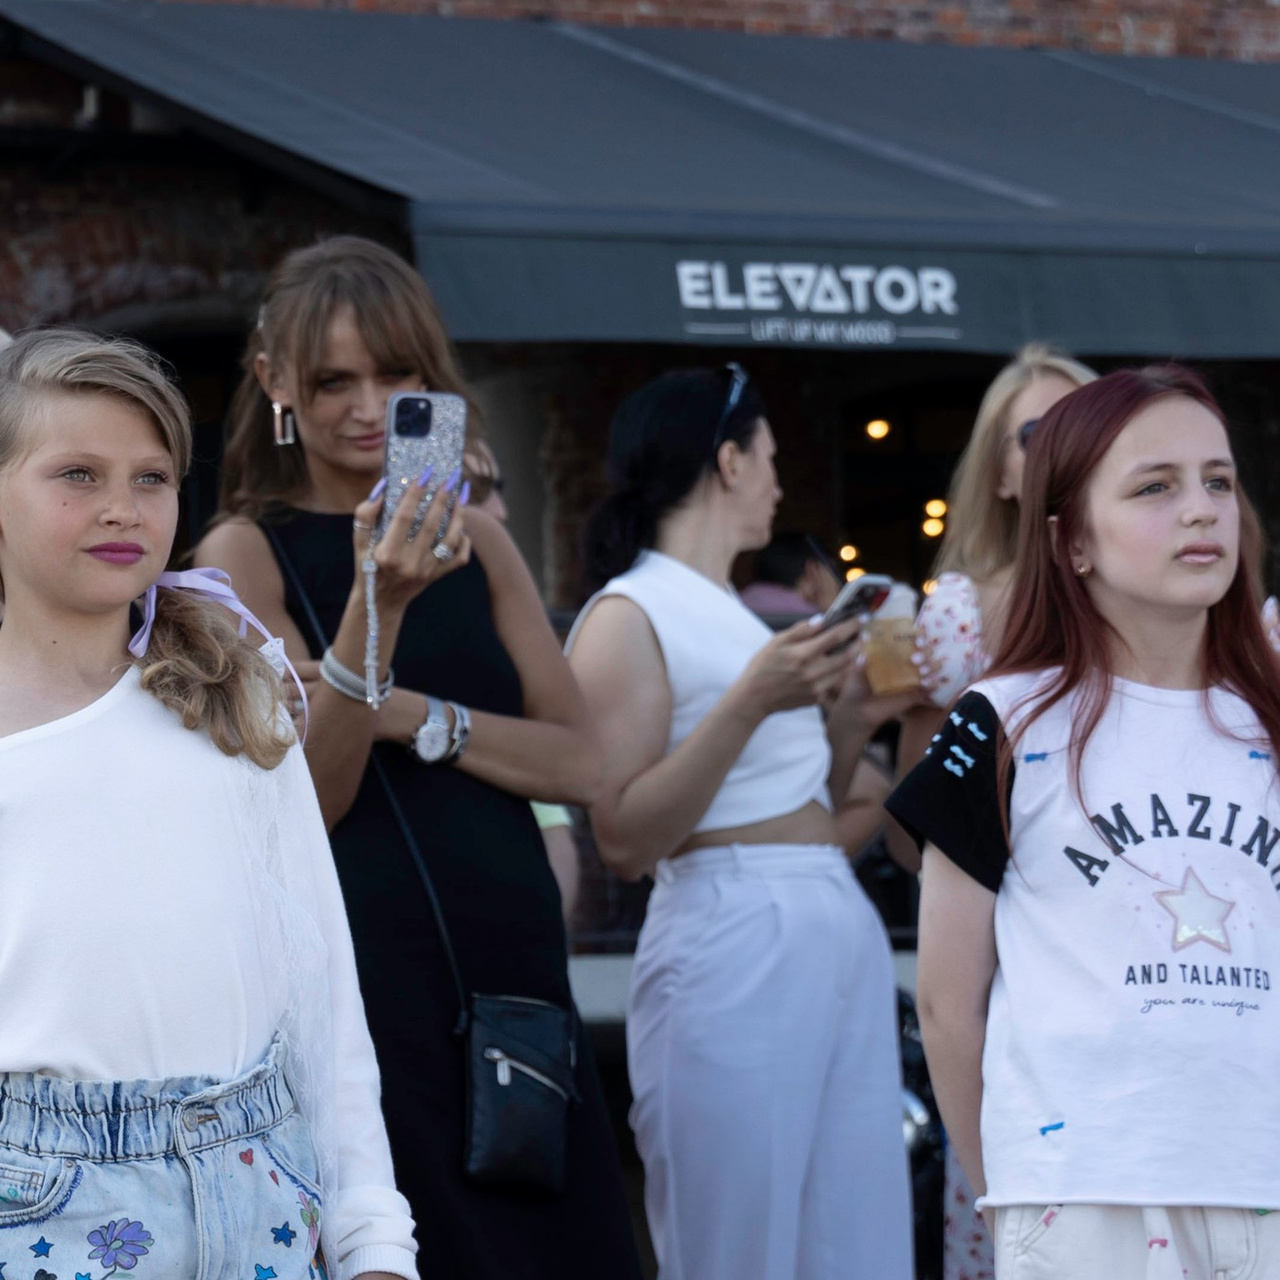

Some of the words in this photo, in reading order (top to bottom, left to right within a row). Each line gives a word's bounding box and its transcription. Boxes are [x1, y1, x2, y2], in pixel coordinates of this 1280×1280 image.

[676, 261, 959, 315] ELEVATOR
[840, 320, 896, 345] MOOD
[1124, 963, 1168, 985] AND
[1178, 963, 1272, 991] TALANTED
[1140, 997, 1176, 1013] you
[1181, 997, 1206, 1006] are
[1211, 998, 1261, 1016] unique
